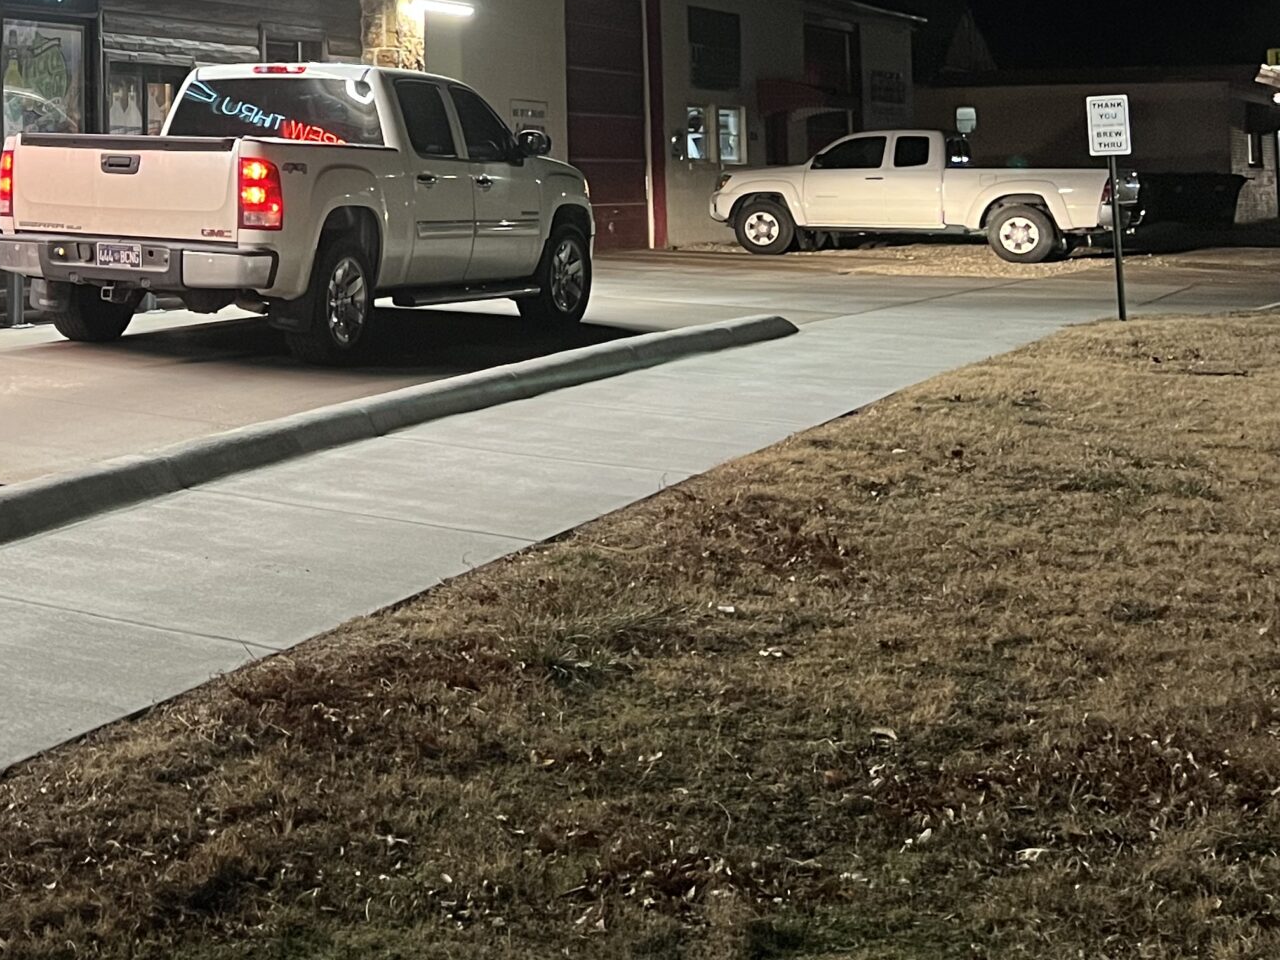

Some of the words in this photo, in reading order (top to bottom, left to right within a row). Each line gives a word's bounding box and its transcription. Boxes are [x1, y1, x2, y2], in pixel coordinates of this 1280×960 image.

[1092, 101, 1122, 109] THANK
[1099, 112, 1117, 120] YOU
[1096, 130, 1122, 138] BREW
[1098, 141, 1122, 149] THRU
[201, 228, 232, 238] GMC
